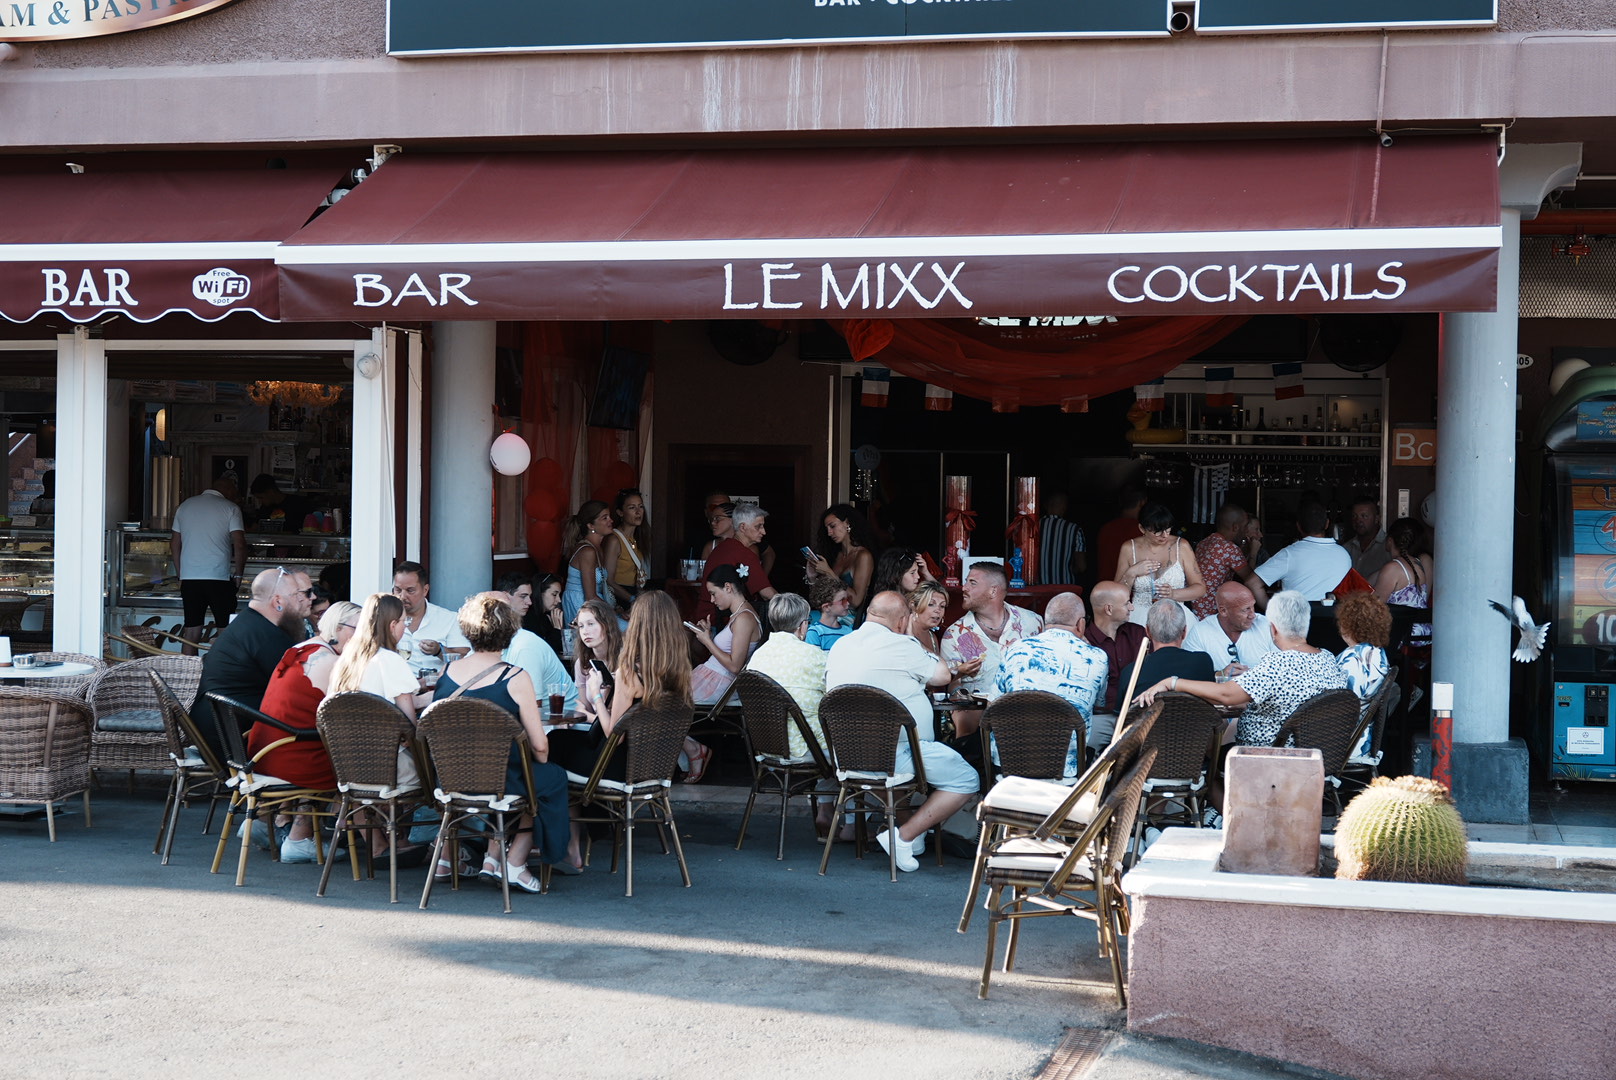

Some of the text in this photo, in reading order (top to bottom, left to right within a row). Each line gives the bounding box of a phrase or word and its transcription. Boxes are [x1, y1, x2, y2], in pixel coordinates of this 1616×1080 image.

[48, 1, 71, 26] &
[42, 268, 138, 306] BAR
[352, 272, 478, 307] BAR
[722, 262, 974, 310] LE MIXX
[1107, 262, 1407, 303] COCKTAILS
